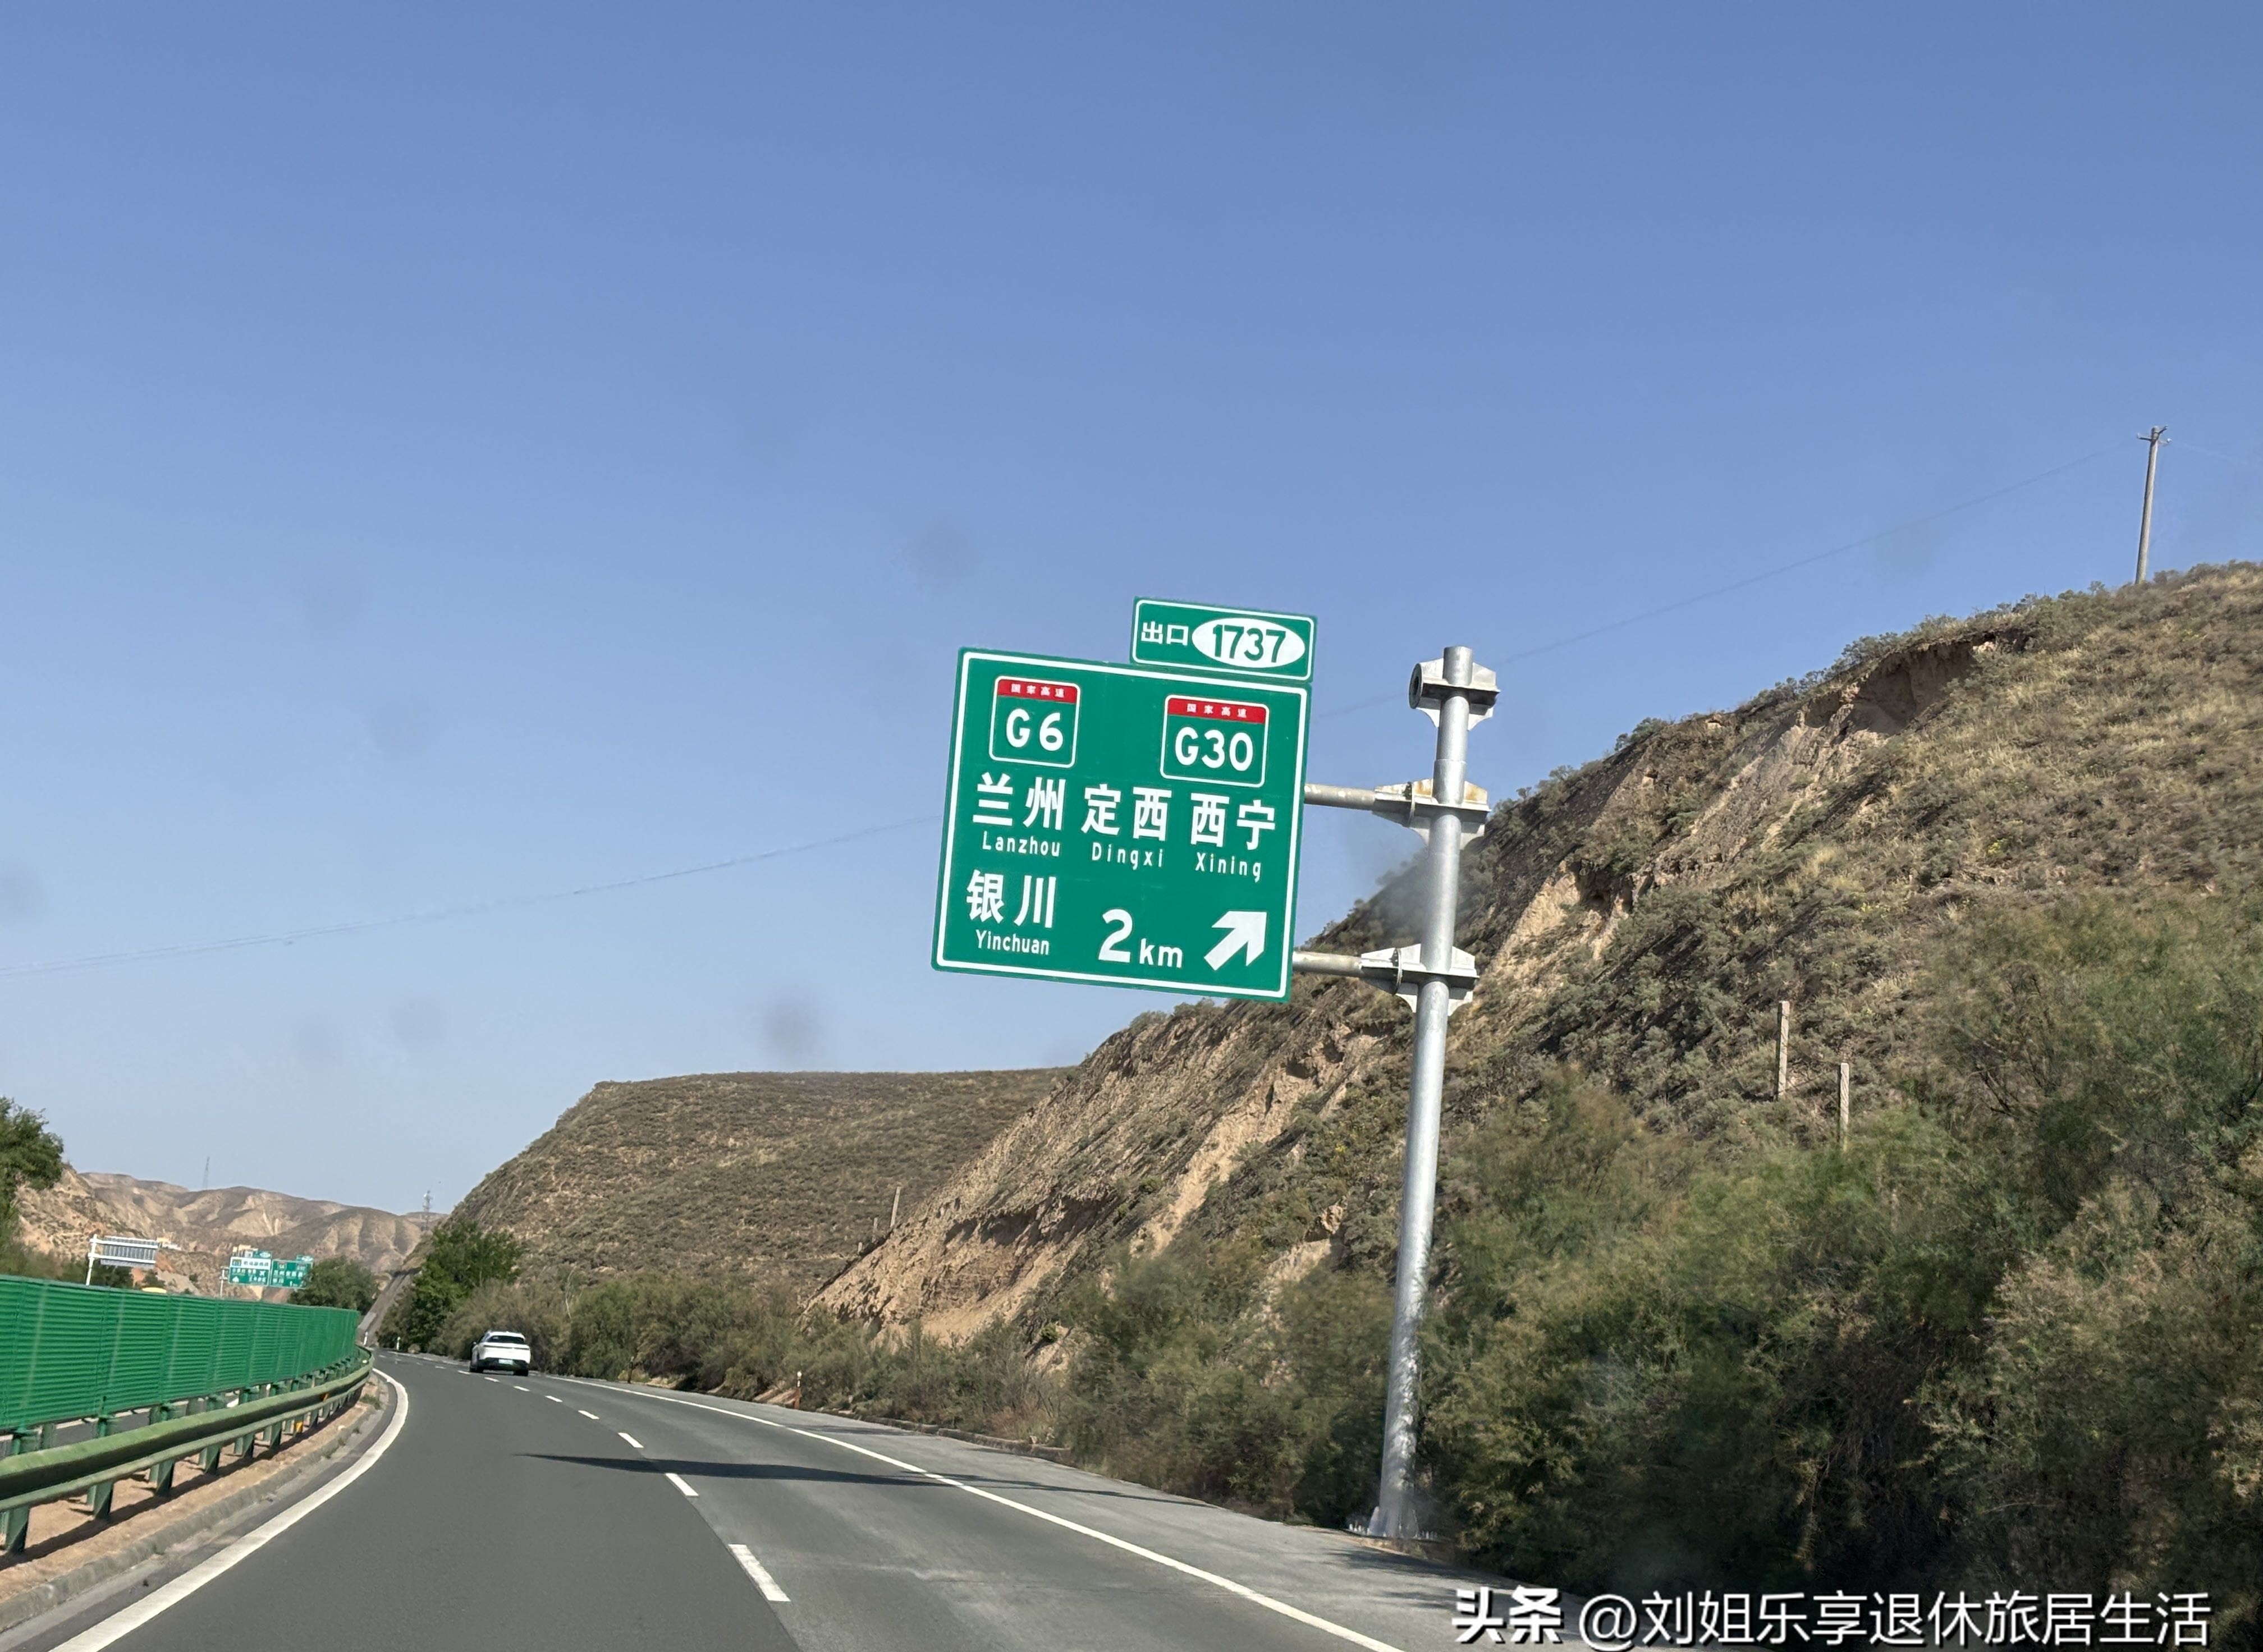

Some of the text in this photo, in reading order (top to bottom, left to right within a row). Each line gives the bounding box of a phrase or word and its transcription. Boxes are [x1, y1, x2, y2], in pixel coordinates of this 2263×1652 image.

[1142, 621, 1286, 663] 出口 1737
[1011, 683, 1065, 698] 国家高速
[1006, 708, 1064, 751] G6
[1175, 726, 1254, 772] G30
[973, 772, 1276, 851] 兰州 定西 西宁
[983, 831, 1261, 882] Lanzhou Dingxi Xining
[966, 869, 1057, 929] 银川
[975, 930, 1050, 956] Yinchuan
